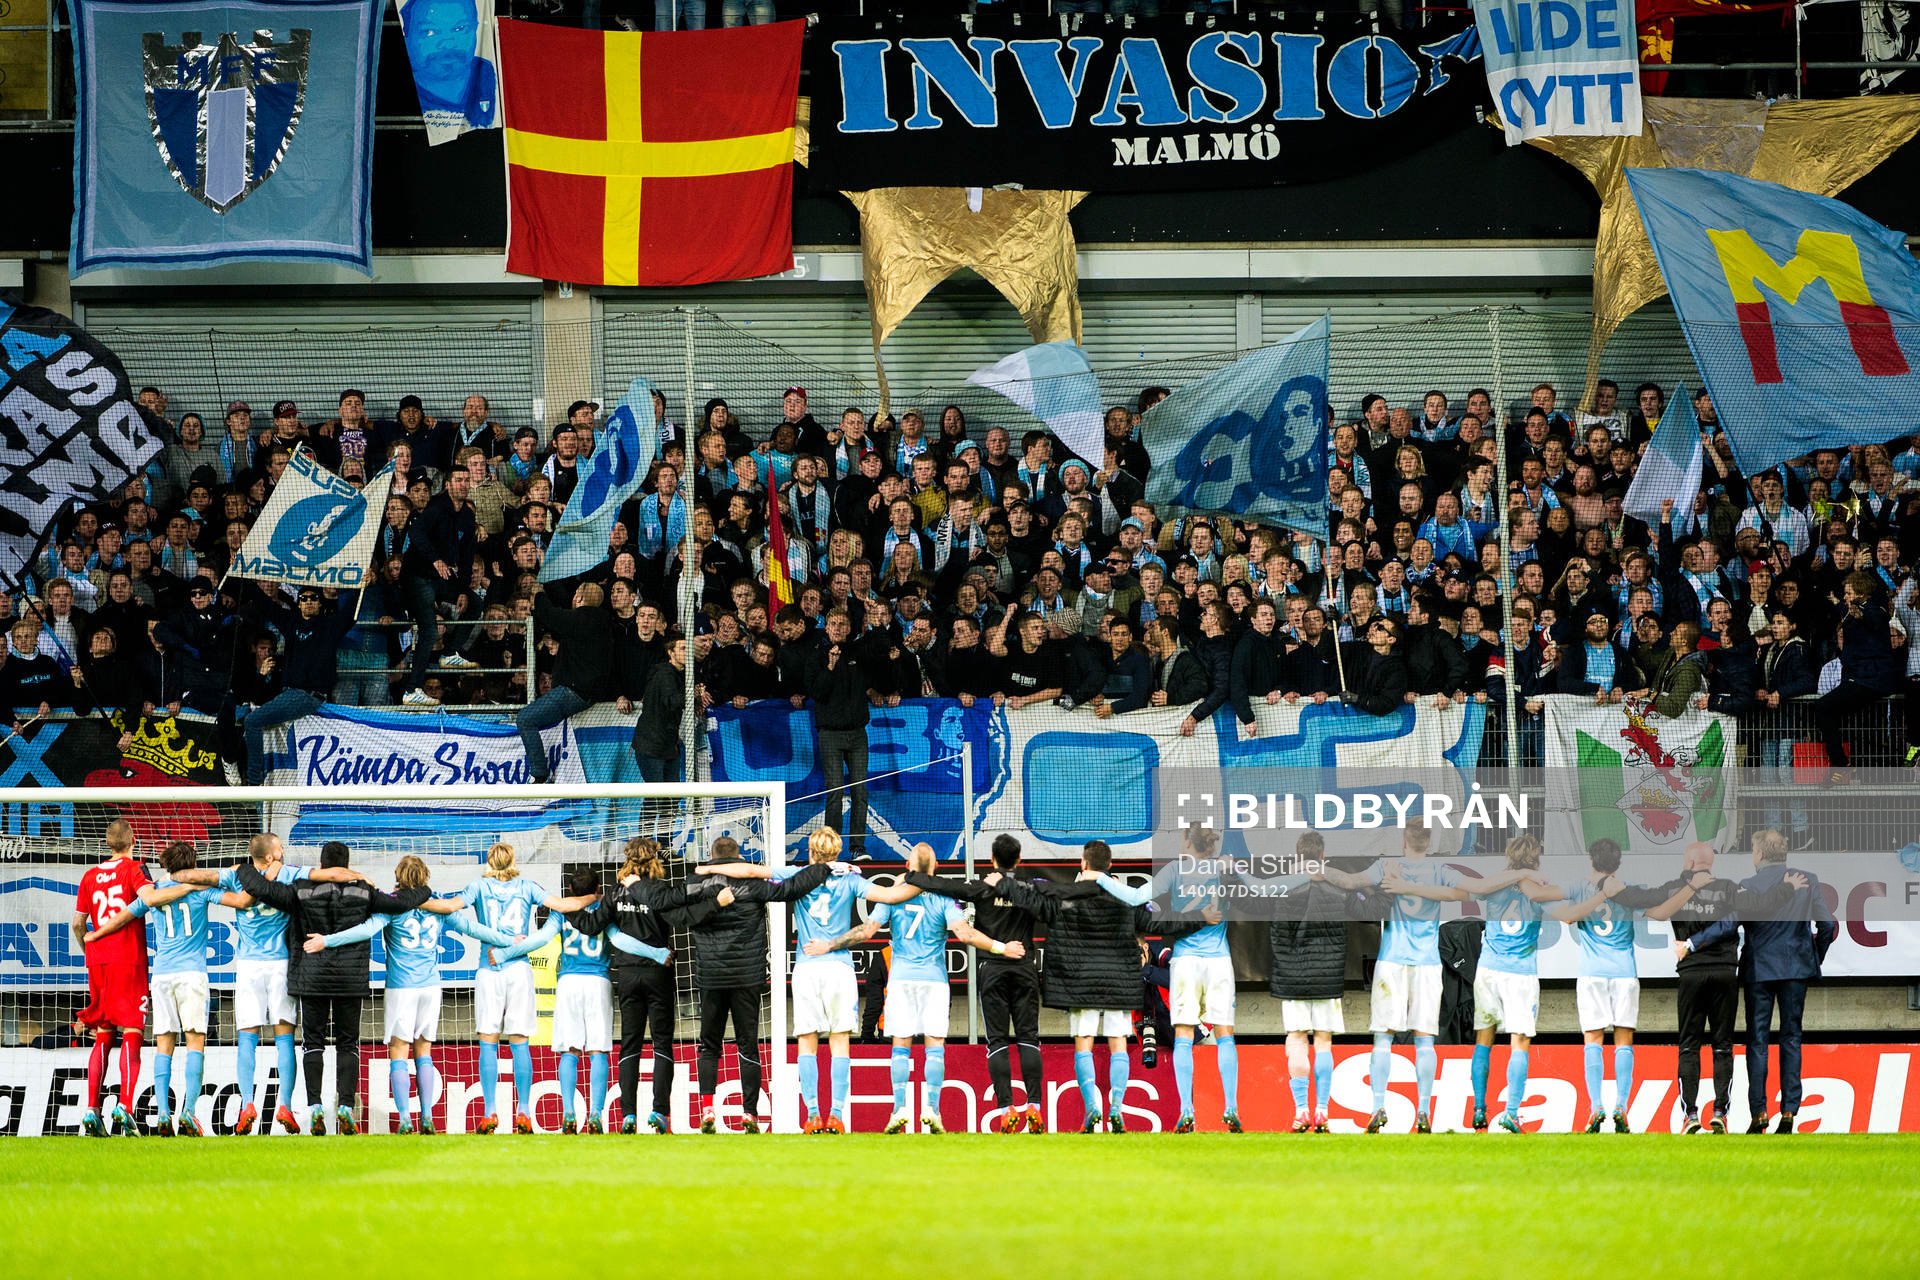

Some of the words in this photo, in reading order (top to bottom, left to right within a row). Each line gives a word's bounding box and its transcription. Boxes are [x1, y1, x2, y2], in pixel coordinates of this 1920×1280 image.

[176, 52, 277, 85] MFF
[1111, 124, 1281, 166] MALMÖ
[1705, 229, 1910, 385] M
[297, 735, 431, 786] Kämpa
[92, 883, 128, 926] 25
[161, 902, 193, 938] 11
[487, 897, 522, 934] 14
[808, 894, 833, 926] 4
[904, 904, 926, 939] 7
[1501, 899, 1522, 935] 6
[1593, 902, 1614, 937] 3
[401, 916, 439, 950] 33
[369, 1057, 802, 1134] Priorite
[842, 1058, 1162, 1134] Finans
[1328, 1051, 1911, 1134] Stavdal
